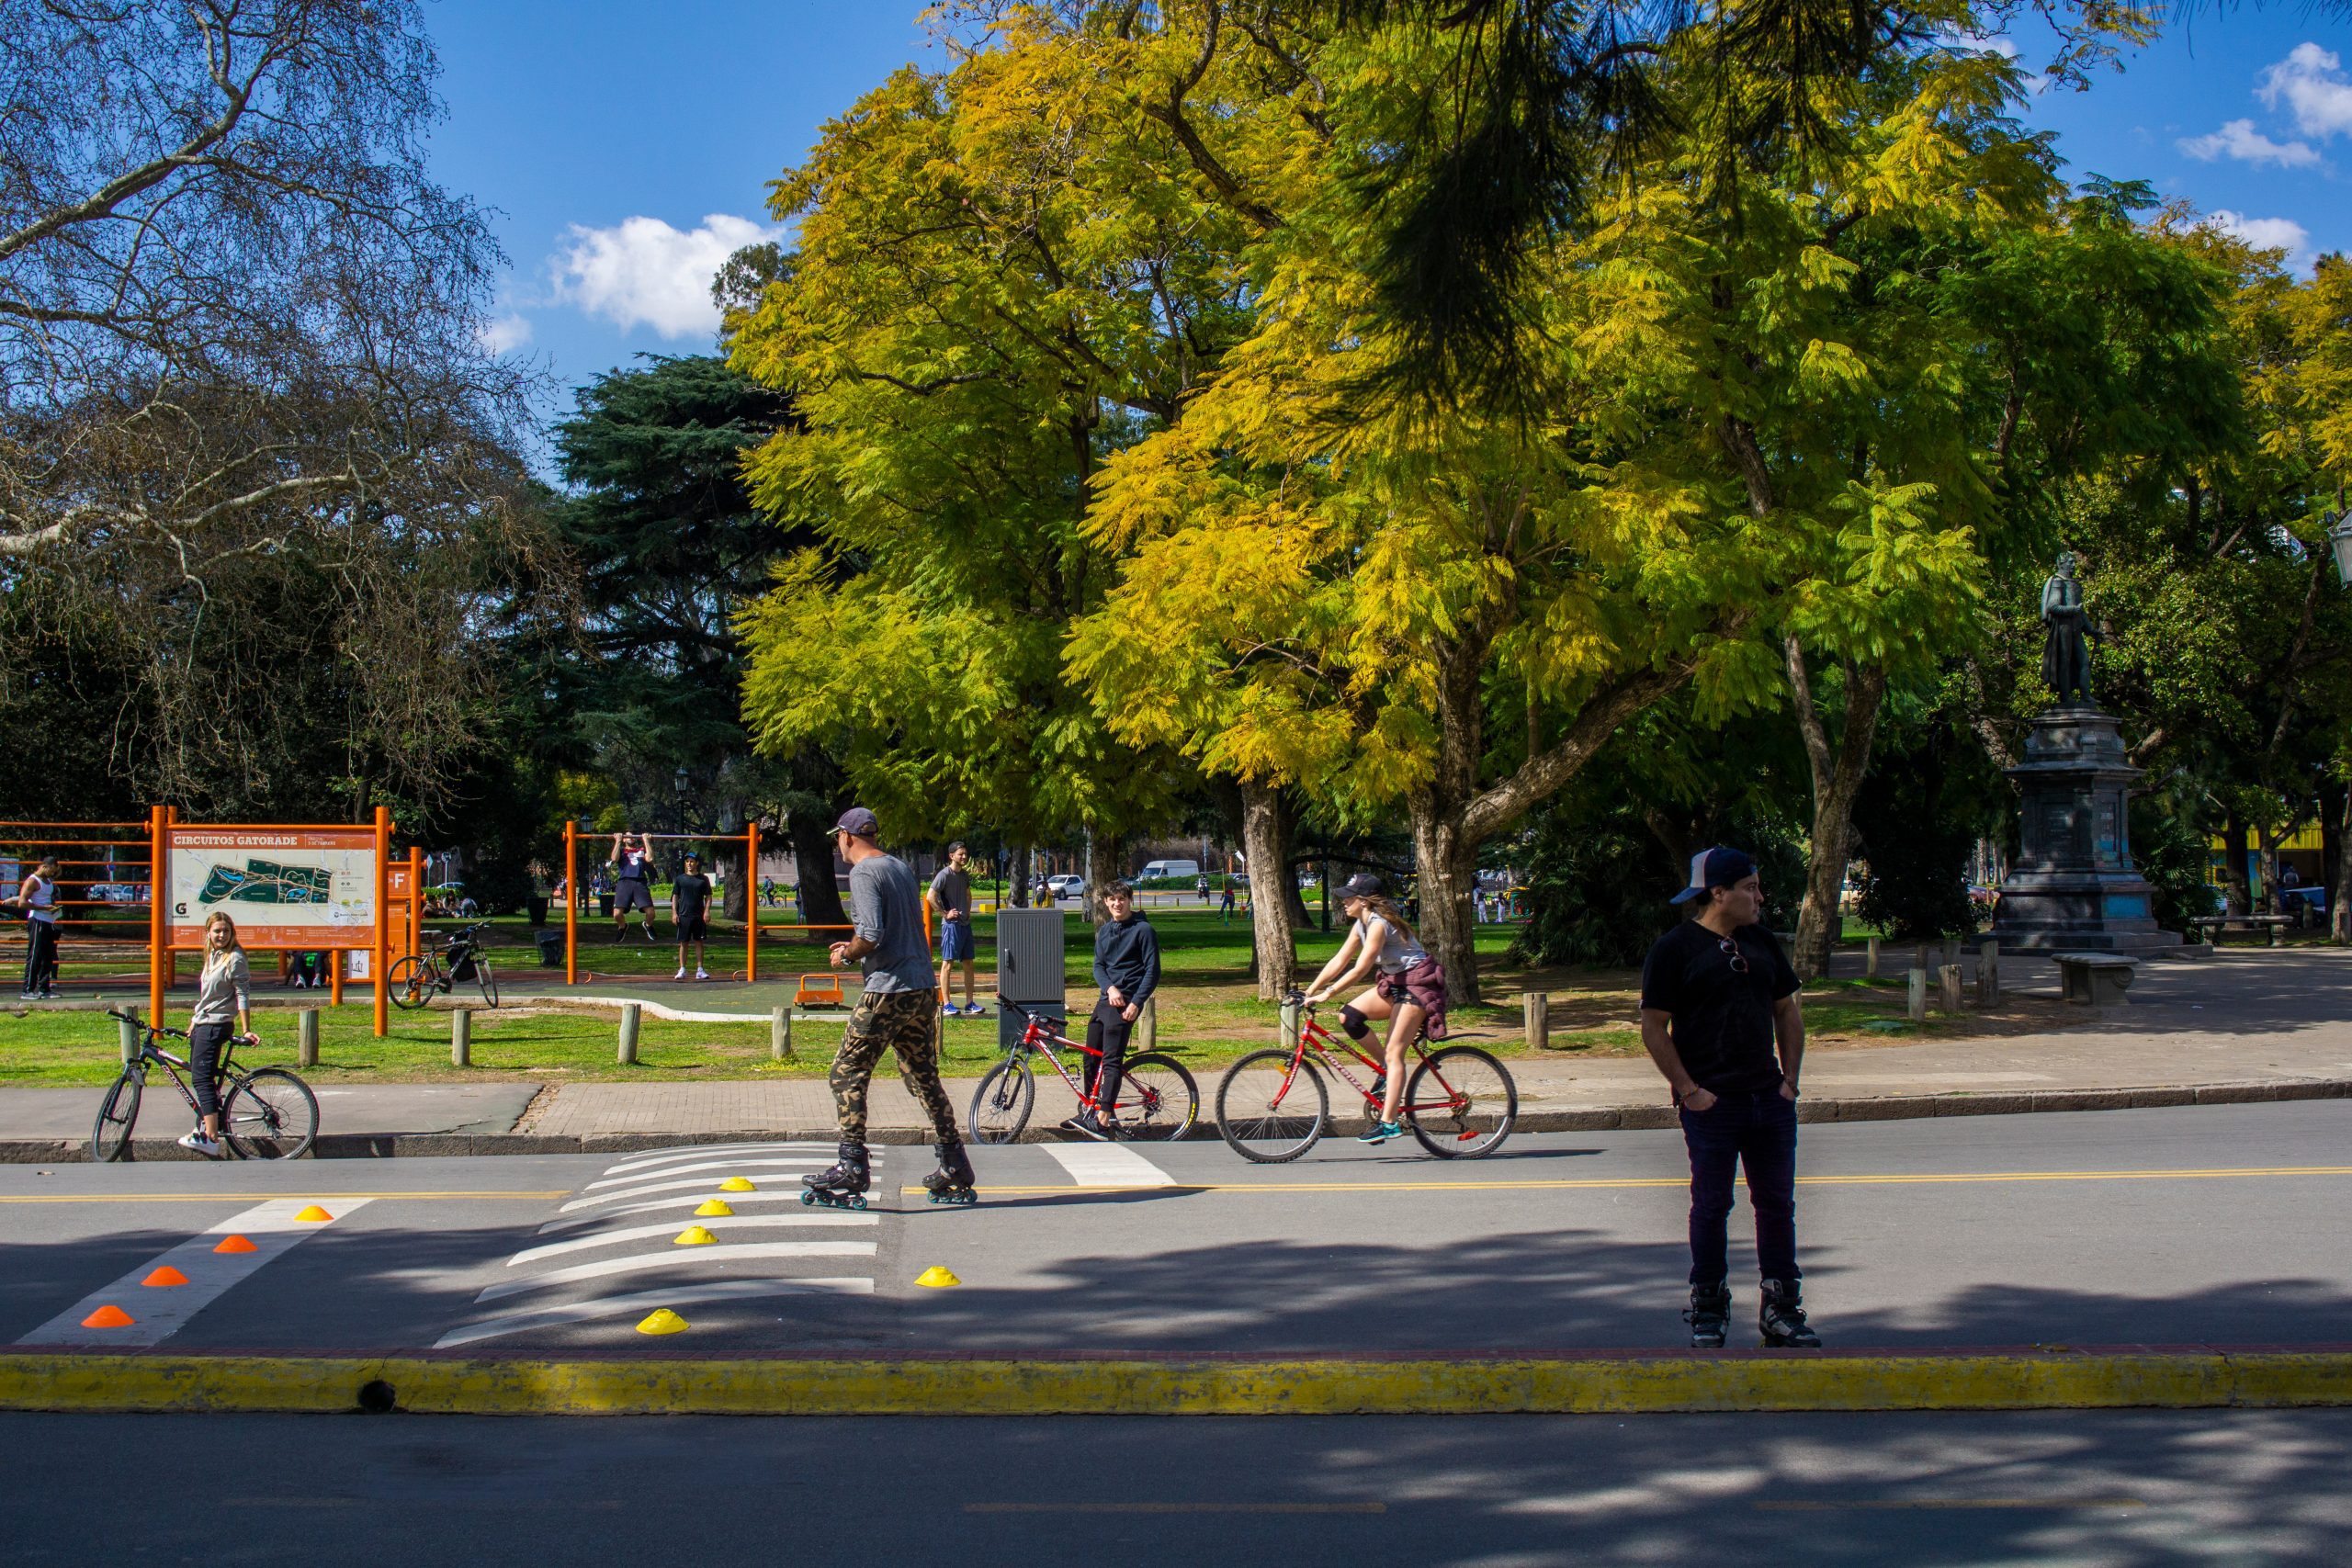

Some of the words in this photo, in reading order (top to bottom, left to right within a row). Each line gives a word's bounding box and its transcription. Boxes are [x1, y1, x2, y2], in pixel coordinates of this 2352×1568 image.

[174, 836, 234, 845] CIRCUITOS
[236, 836, 298, 846] GATORADE
[395, 874, 404, 888] F
[175, 902, 187, 914] G
